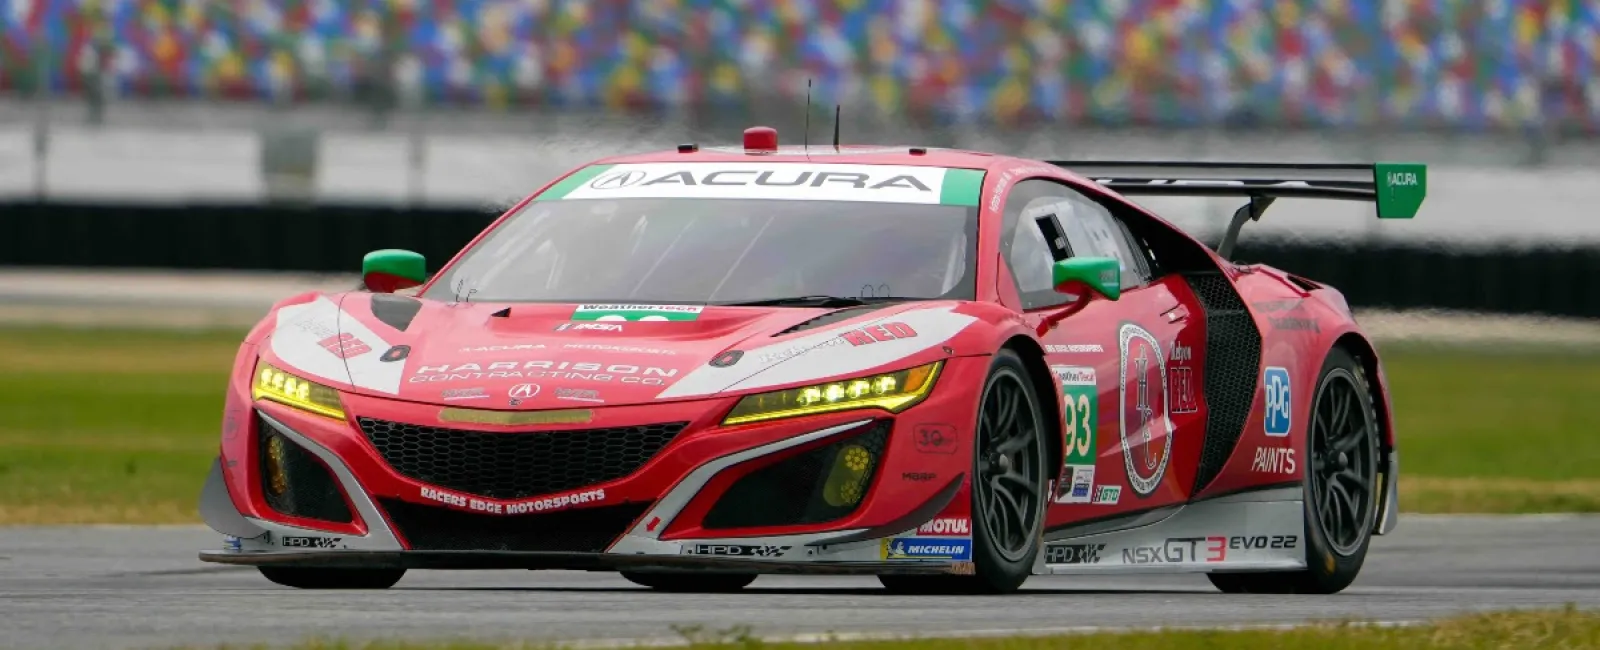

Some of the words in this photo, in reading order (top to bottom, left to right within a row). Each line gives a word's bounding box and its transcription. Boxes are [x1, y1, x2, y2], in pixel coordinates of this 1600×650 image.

[650, 170, 932, 192] ACURA
[1391, 172, 1419, 186] ACURA
[840, 322, 918, 347] RED
[417, 360, 679, 378] HARRISON
[408, 370, 613, 383] CONTRACTING
[620, 376, 665, 386] CO.
[1064, 393, 1092, 457] 93
[1251, 447, 1296, 474] PAINTS
[420, 486, 467, 507] RACERS
[469, 499, 502, 514] EDGE
[506, 488, 605, 514] MOTORSPORTS
[919, 518, 969, 534] MOTUL
[283, 537, 310, 547] HPD
[695, 545, 743, 555] HPD
[907, 545, 965, 555] MICHELIN
[1229, 536, 1268, 550] EVO
[1270, 535, 1298, 549] 22
[1046, 545, 1074, 564] HPD
